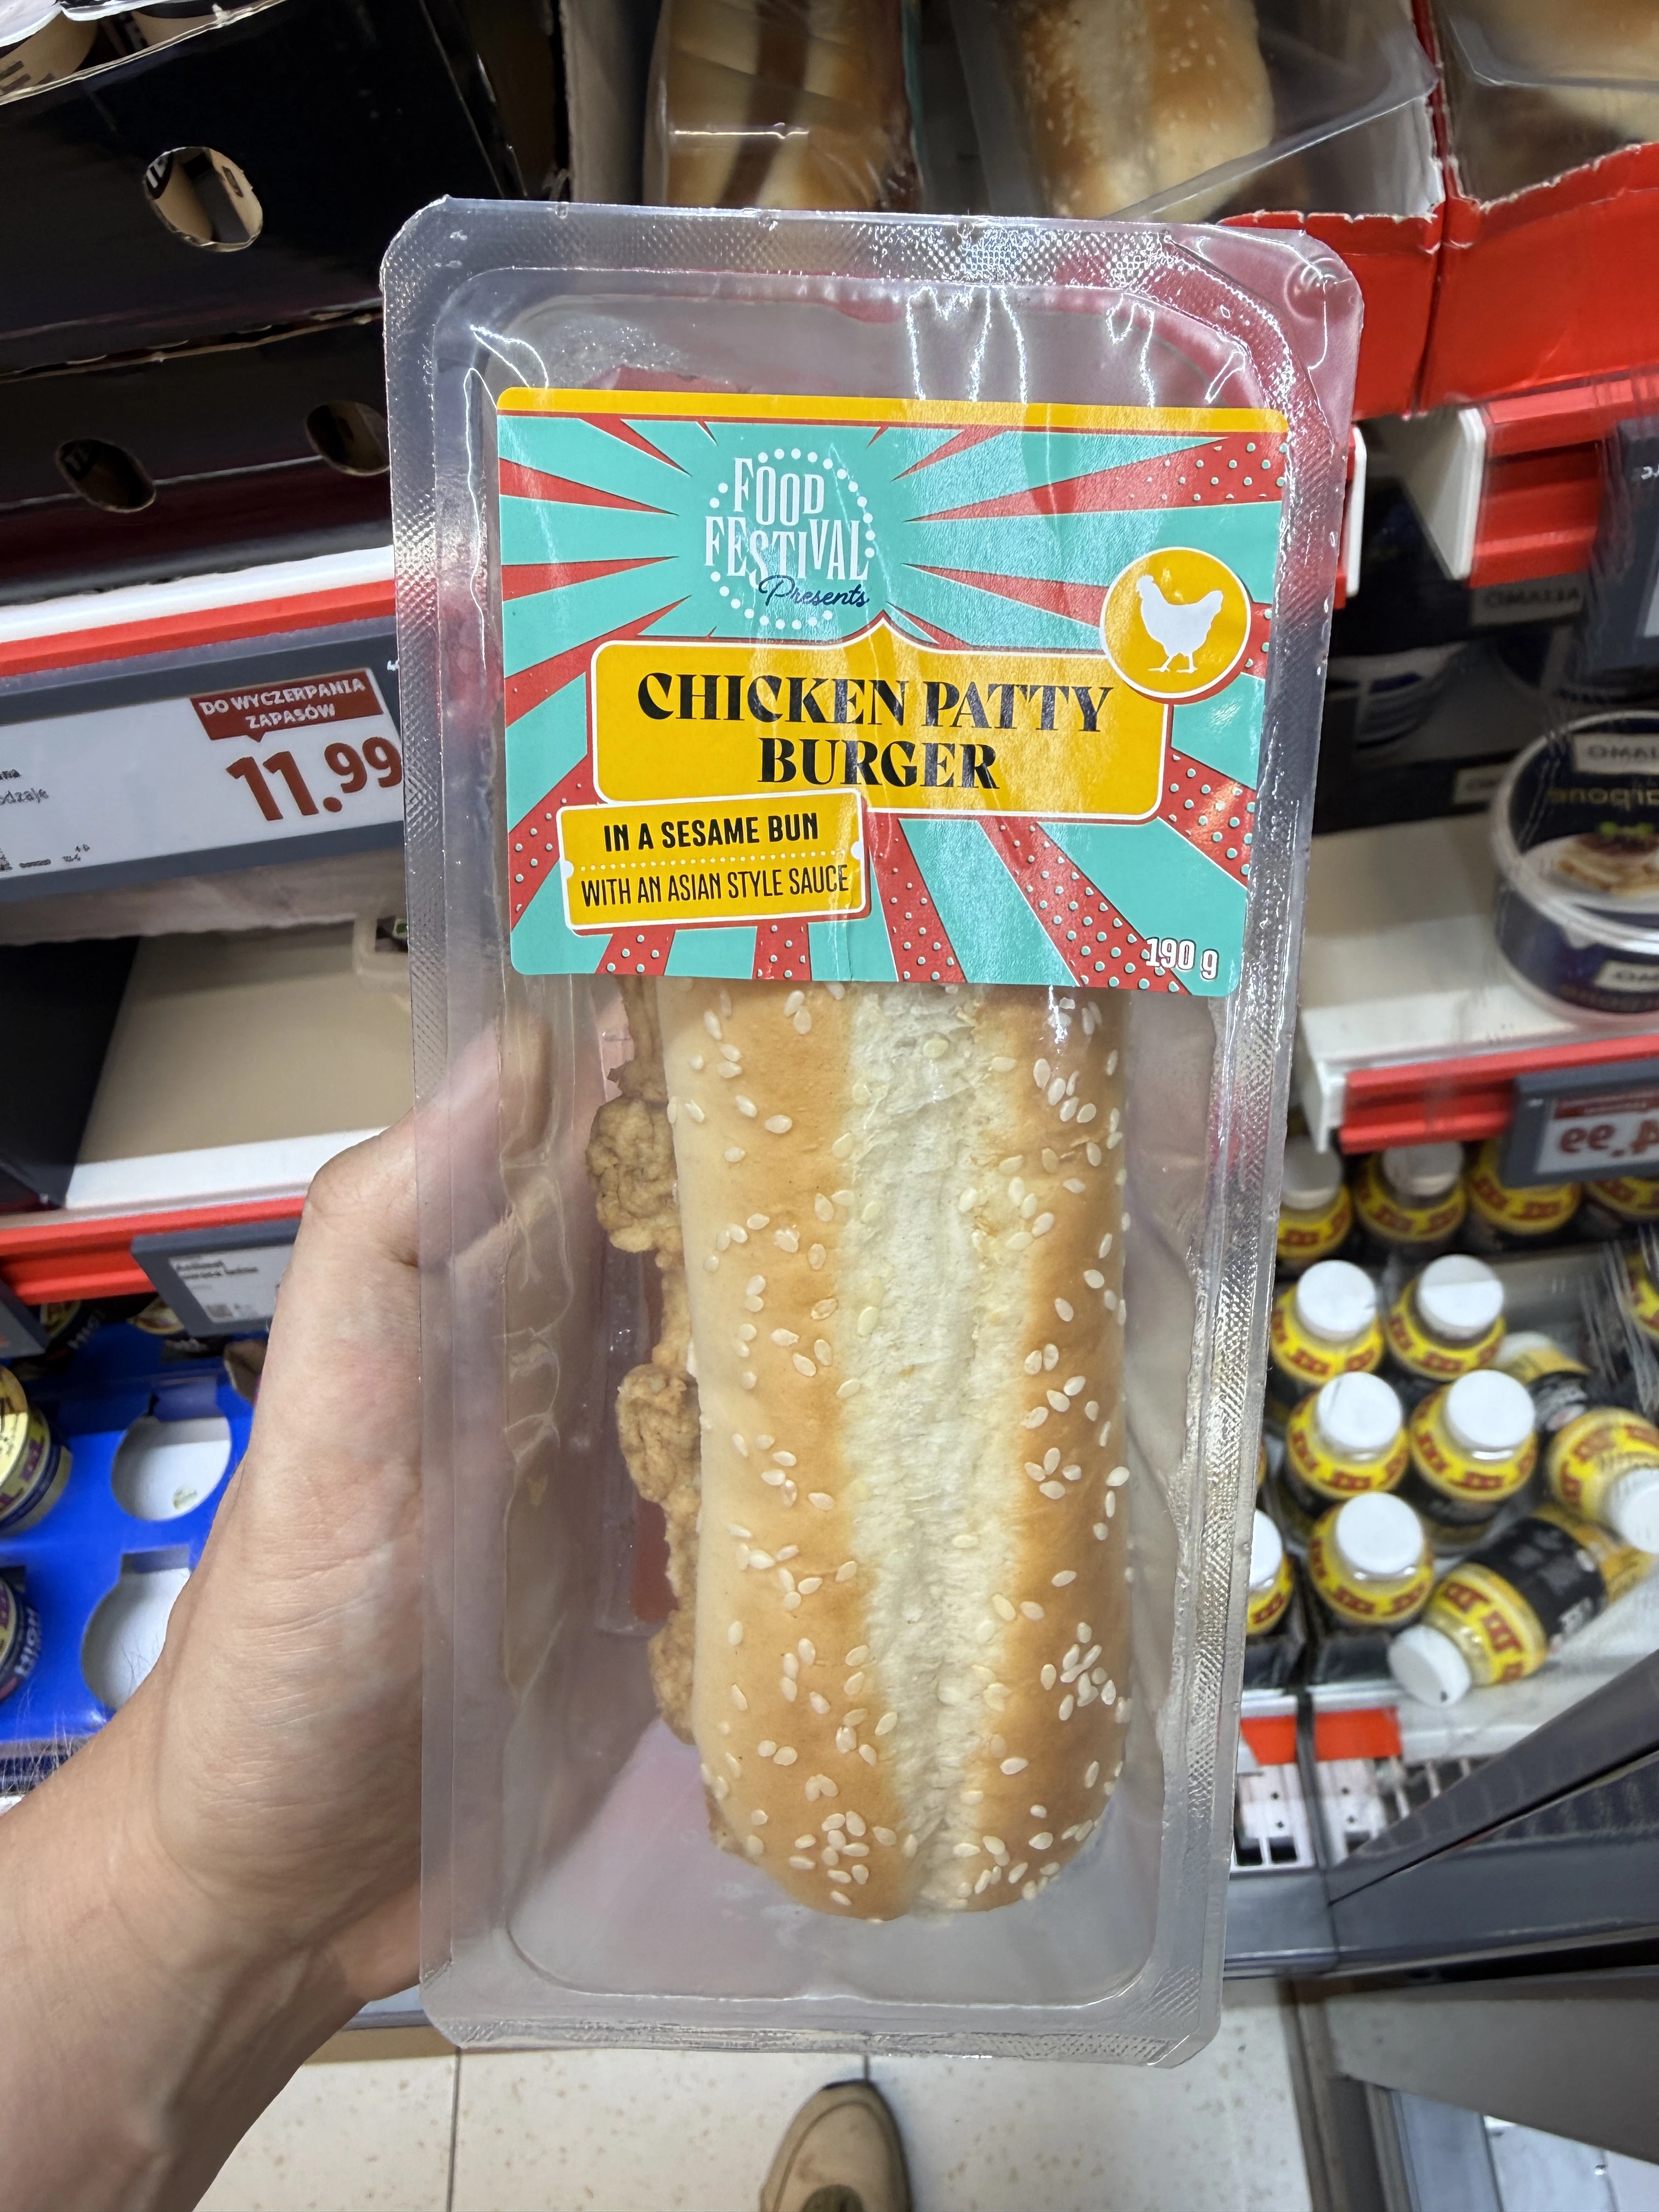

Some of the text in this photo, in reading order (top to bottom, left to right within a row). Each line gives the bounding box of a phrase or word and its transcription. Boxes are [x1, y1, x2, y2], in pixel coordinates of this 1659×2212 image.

[733, 457, 825, 526] FOOD
[705, 516, 868, 590] FESTIVAL
[759, 574, 870, 608] Presents
[199, 678, 366, 715] DO WYCZERPANIA
[245, 703, 336, 730] ZAPASÓW
[638, 672, 1114, 732] CHICKEN PATTY
[226, 736, 403, 821] 11.99
[757, 737, 1000, 789] BURGER
[604, 812, 818, 852] IN A SESAME BUN
[581, 864, 849, 907] WITH AN ASIAN STYLE SAUCE
[1146, 937, 1219, 980] 190 g
